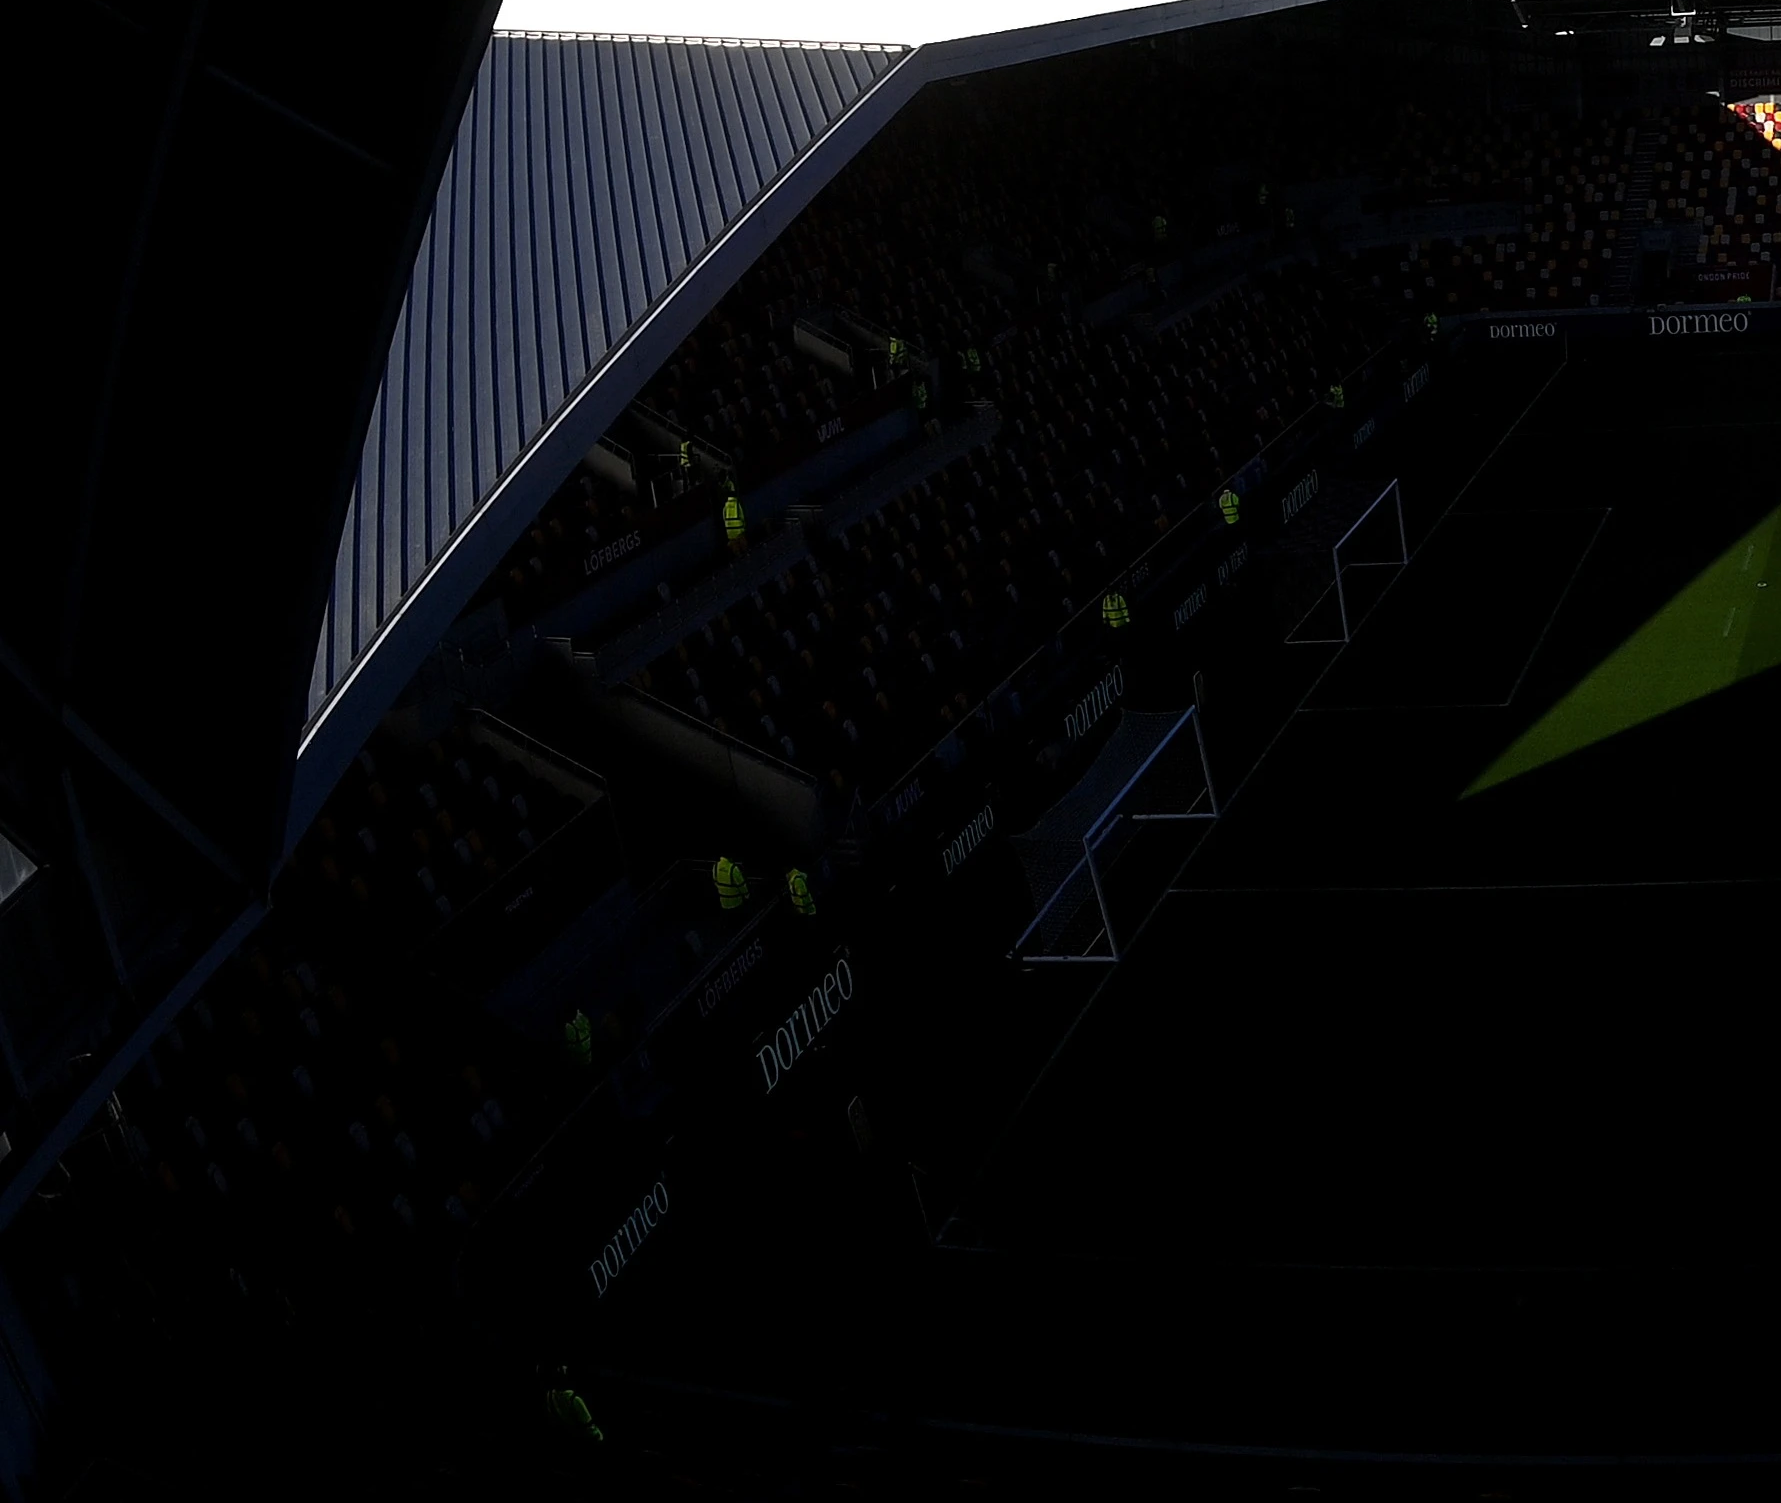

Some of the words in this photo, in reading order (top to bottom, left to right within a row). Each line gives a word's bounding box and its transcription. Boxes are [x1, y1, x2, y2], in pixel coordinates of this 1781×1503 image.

[1488, 322, 1556, 339] Dormeo
[1648, 312, 1749, 336] Dormeo
[583, 529, 641, 576] LÖFBERGS
[942, 805, 994, 876] Dormeo
[756, 959, 853, 1095] Dormeo
[587, 1181, 669, 1299] Dormeo
